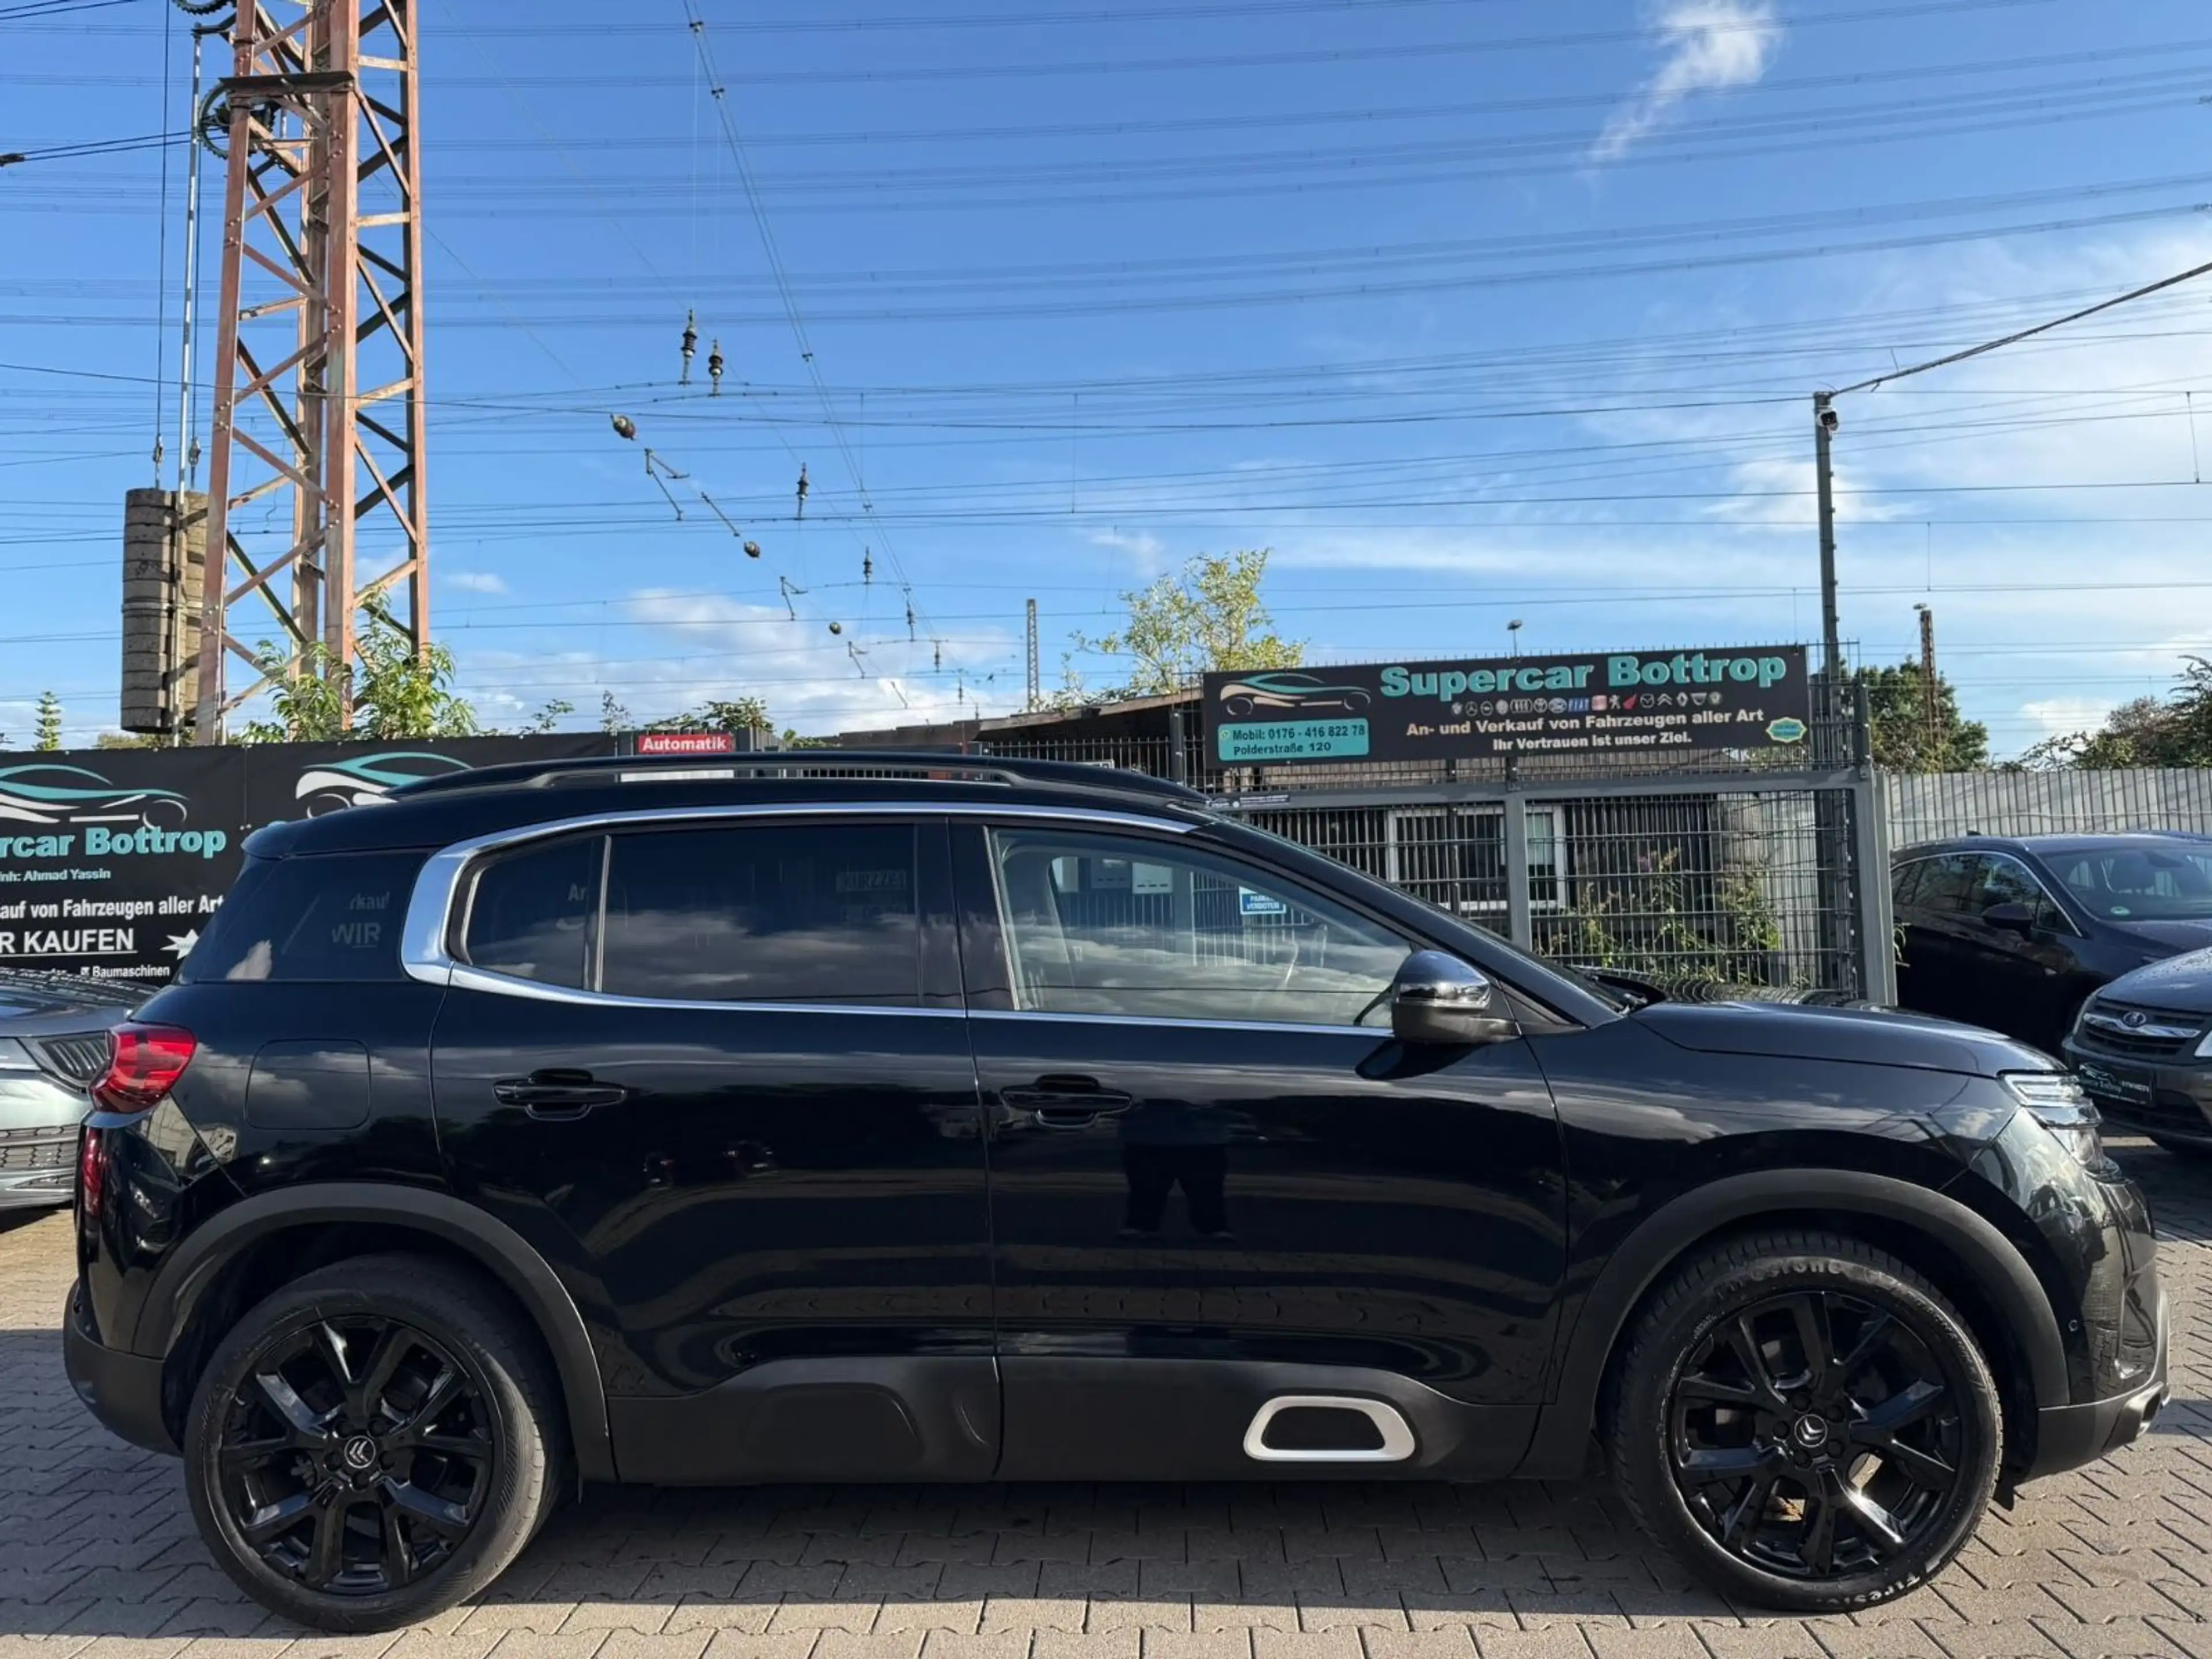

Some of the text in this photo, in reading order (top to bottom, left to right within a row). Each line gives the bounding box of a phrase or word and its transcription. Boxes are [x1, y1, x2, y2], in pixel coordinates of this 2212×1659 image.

[1380, 653, 1786, 702] Supercar Bottrop
[1233, 729, 1266, 741] Mobil:
[1268, 728, 1295, 739] 0176
[1305, 727, 1325, 738] 416
[1328, 725, 1349, 737] 822
[1352, 725, 1365, 735] 78
[1406, 709, 1764, 736] An- und Verkauf von Fahrzeugen aller Art
[643, 737, 727, 751] Automatik
[1494, 739, 1513, 750] Ihr
[1516, 736, 1588, 749] Vertrauen
[1615, 733, 1656, 745] unser
[1659, 731, 1692, 743] Ziel.
[85, 826, 226, 859] Bottrop
[24, 870, 67, 881] Ahmad
[70, 868, 111, 880] Yassin
[31, 903, 58, 918] von
[63, 899, 153, 920] Fahrzeugen
[158, 896, 194, 914] aller
[24, 927, 134, 953] KAUFEN
[92, 964, 170, 978] Baumaschinen
